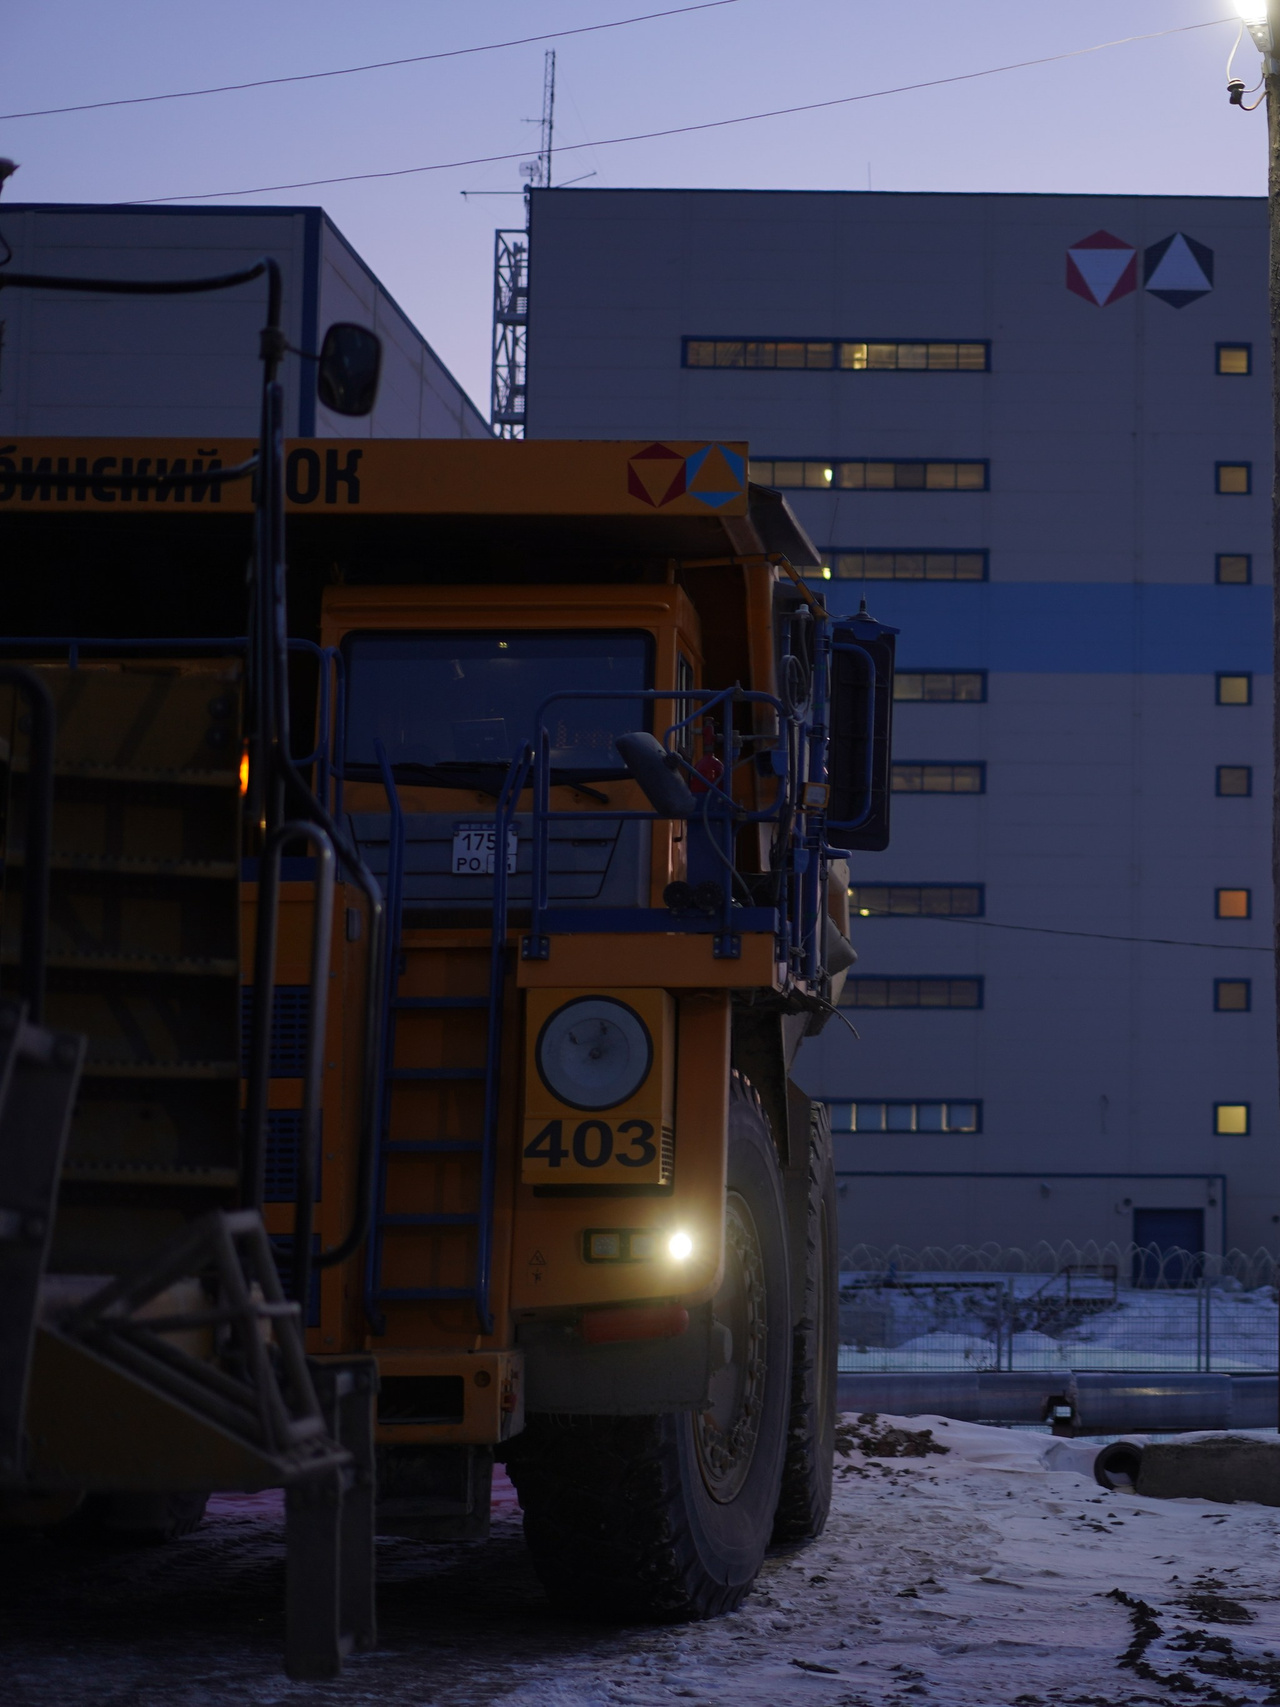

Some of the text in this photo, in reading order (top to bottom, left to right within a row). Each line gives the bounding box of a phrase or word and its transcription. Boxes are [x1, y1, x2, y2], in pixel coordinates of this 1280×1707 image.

[252, 448, 363, 505] ОК
[462, 833, 510, 851] 175
[523, 1119, 657, 1168] 403
